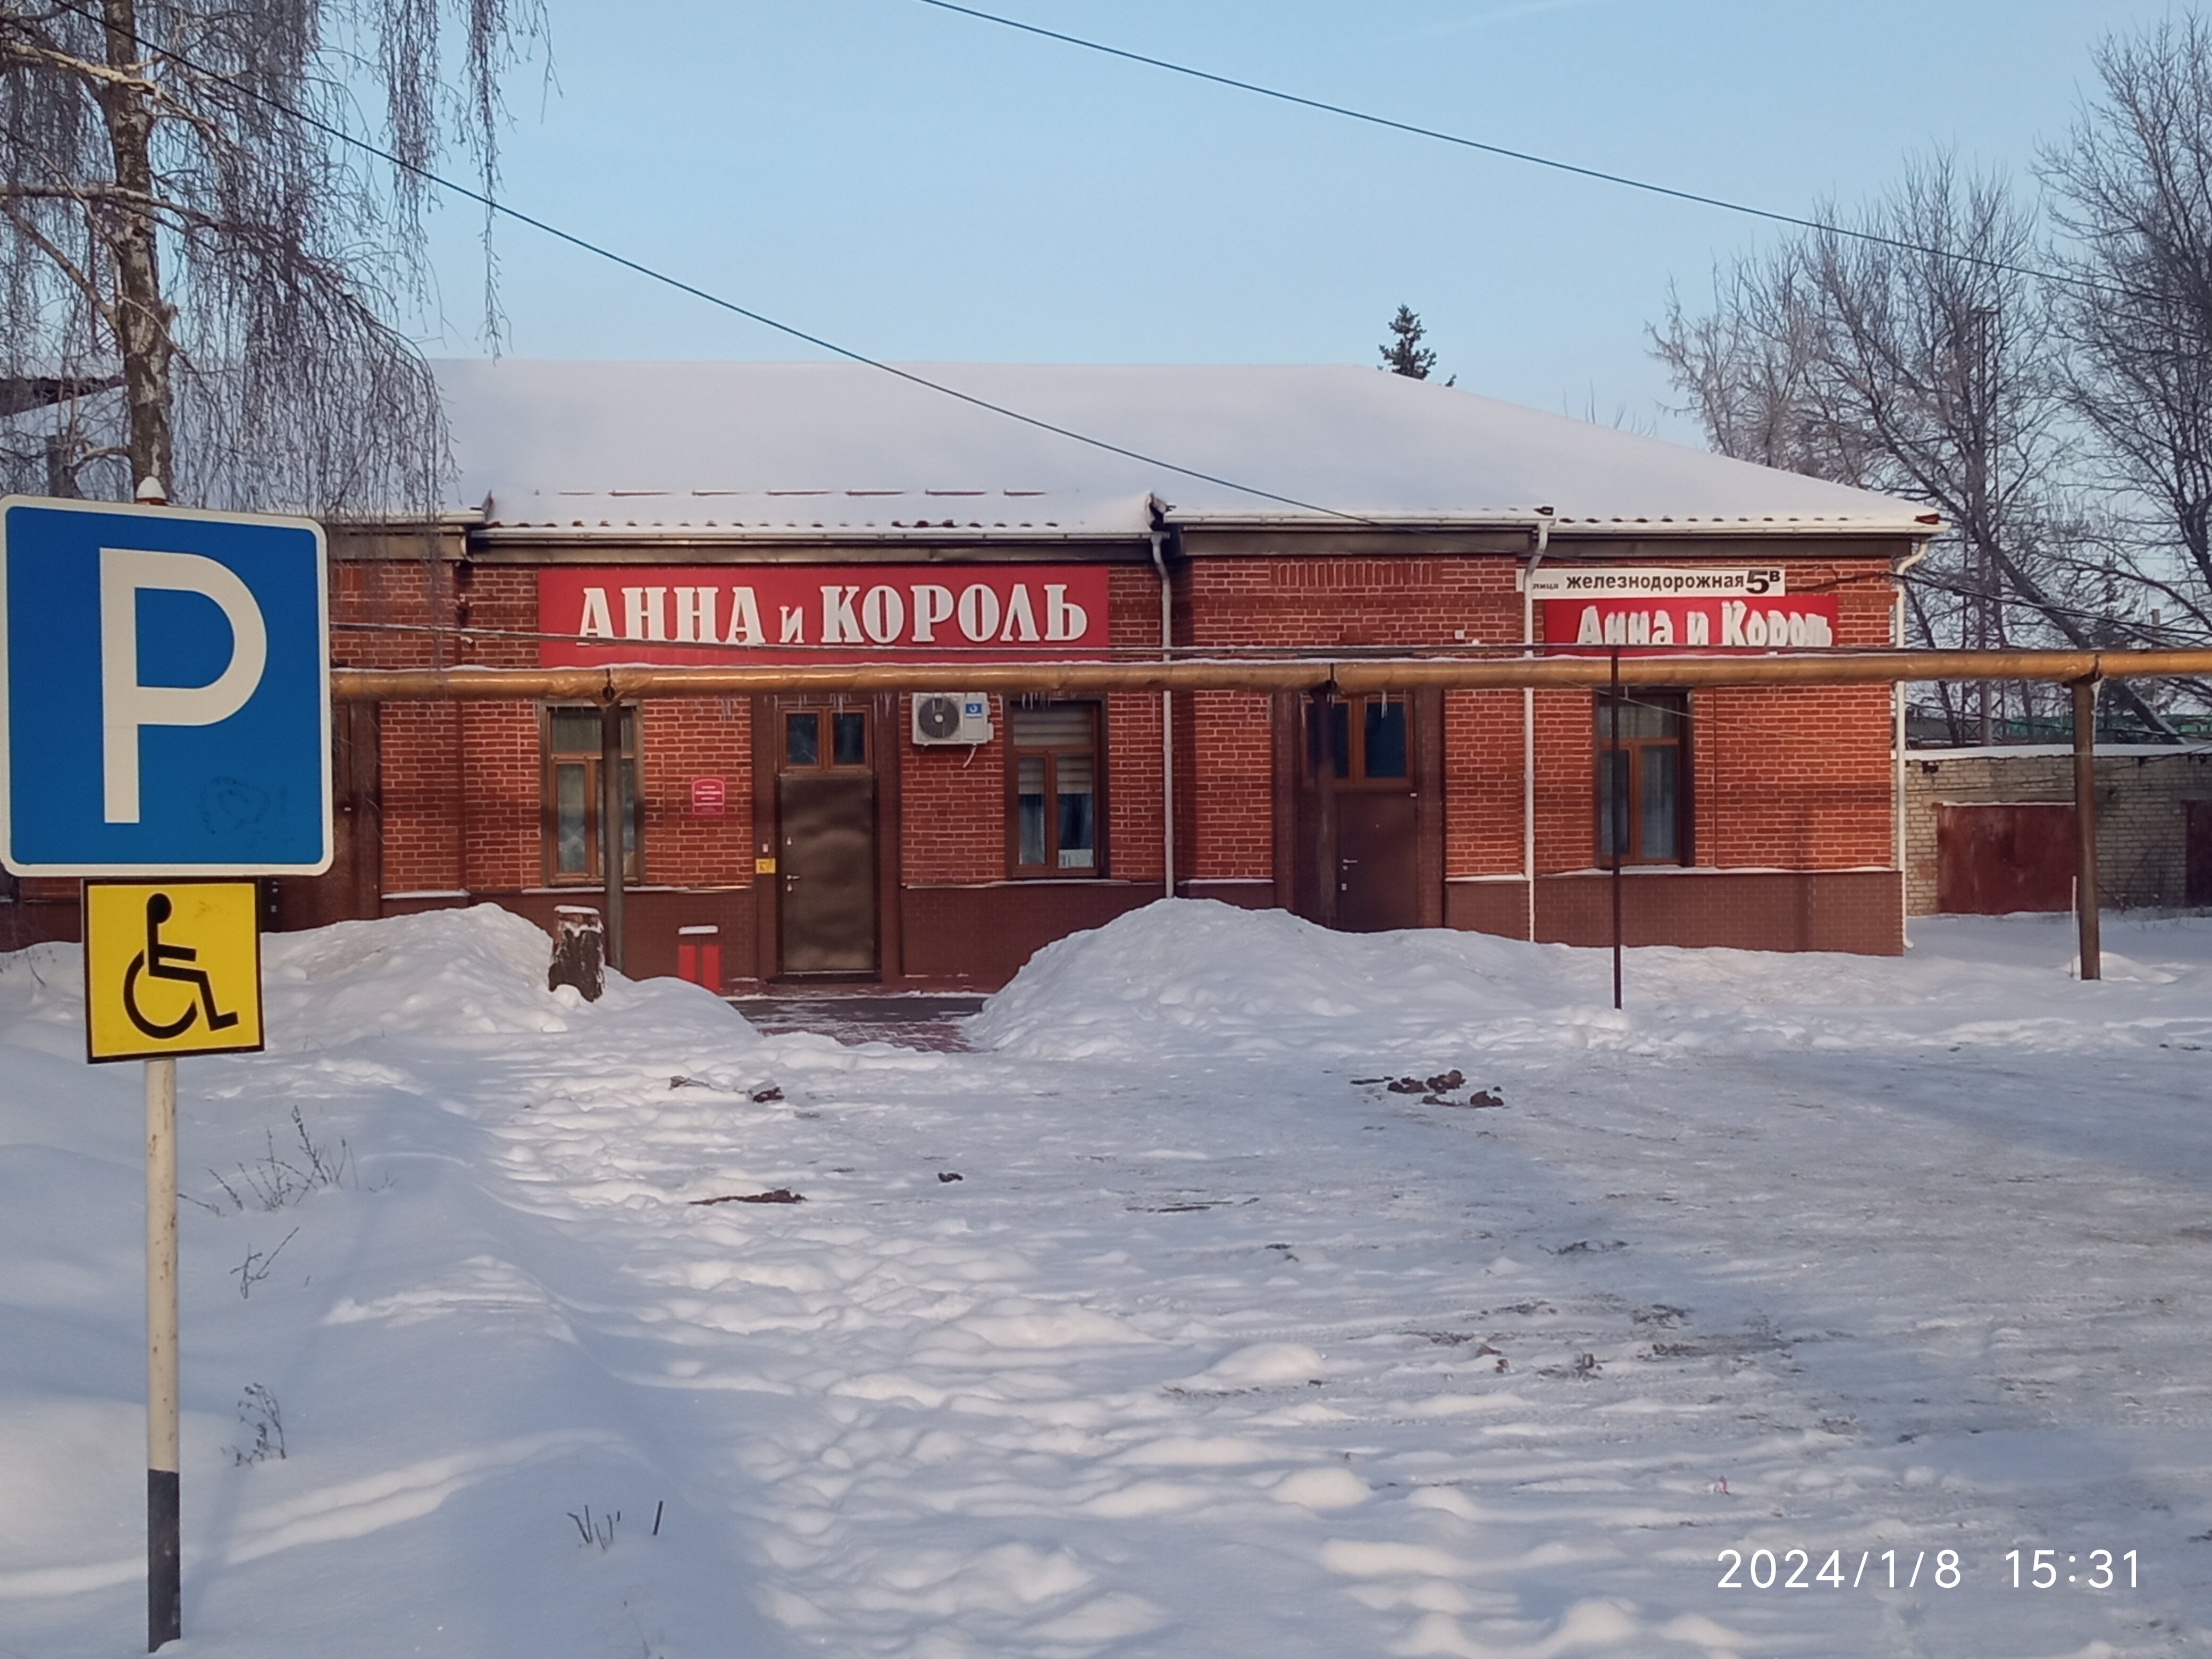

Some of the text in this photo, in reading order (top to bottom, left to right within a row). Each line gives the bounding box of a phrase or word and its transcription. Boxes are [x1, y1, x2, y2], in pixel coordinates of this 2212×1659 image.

[1566, 575, 1744, 592] железнодорожная
[576, 586, 766, 646] АННА
[820, 584, 1087, 643] КОРОЛЬ
[1577, 605, 1673, 645] Анна
[99, 547, 267, 823] P
